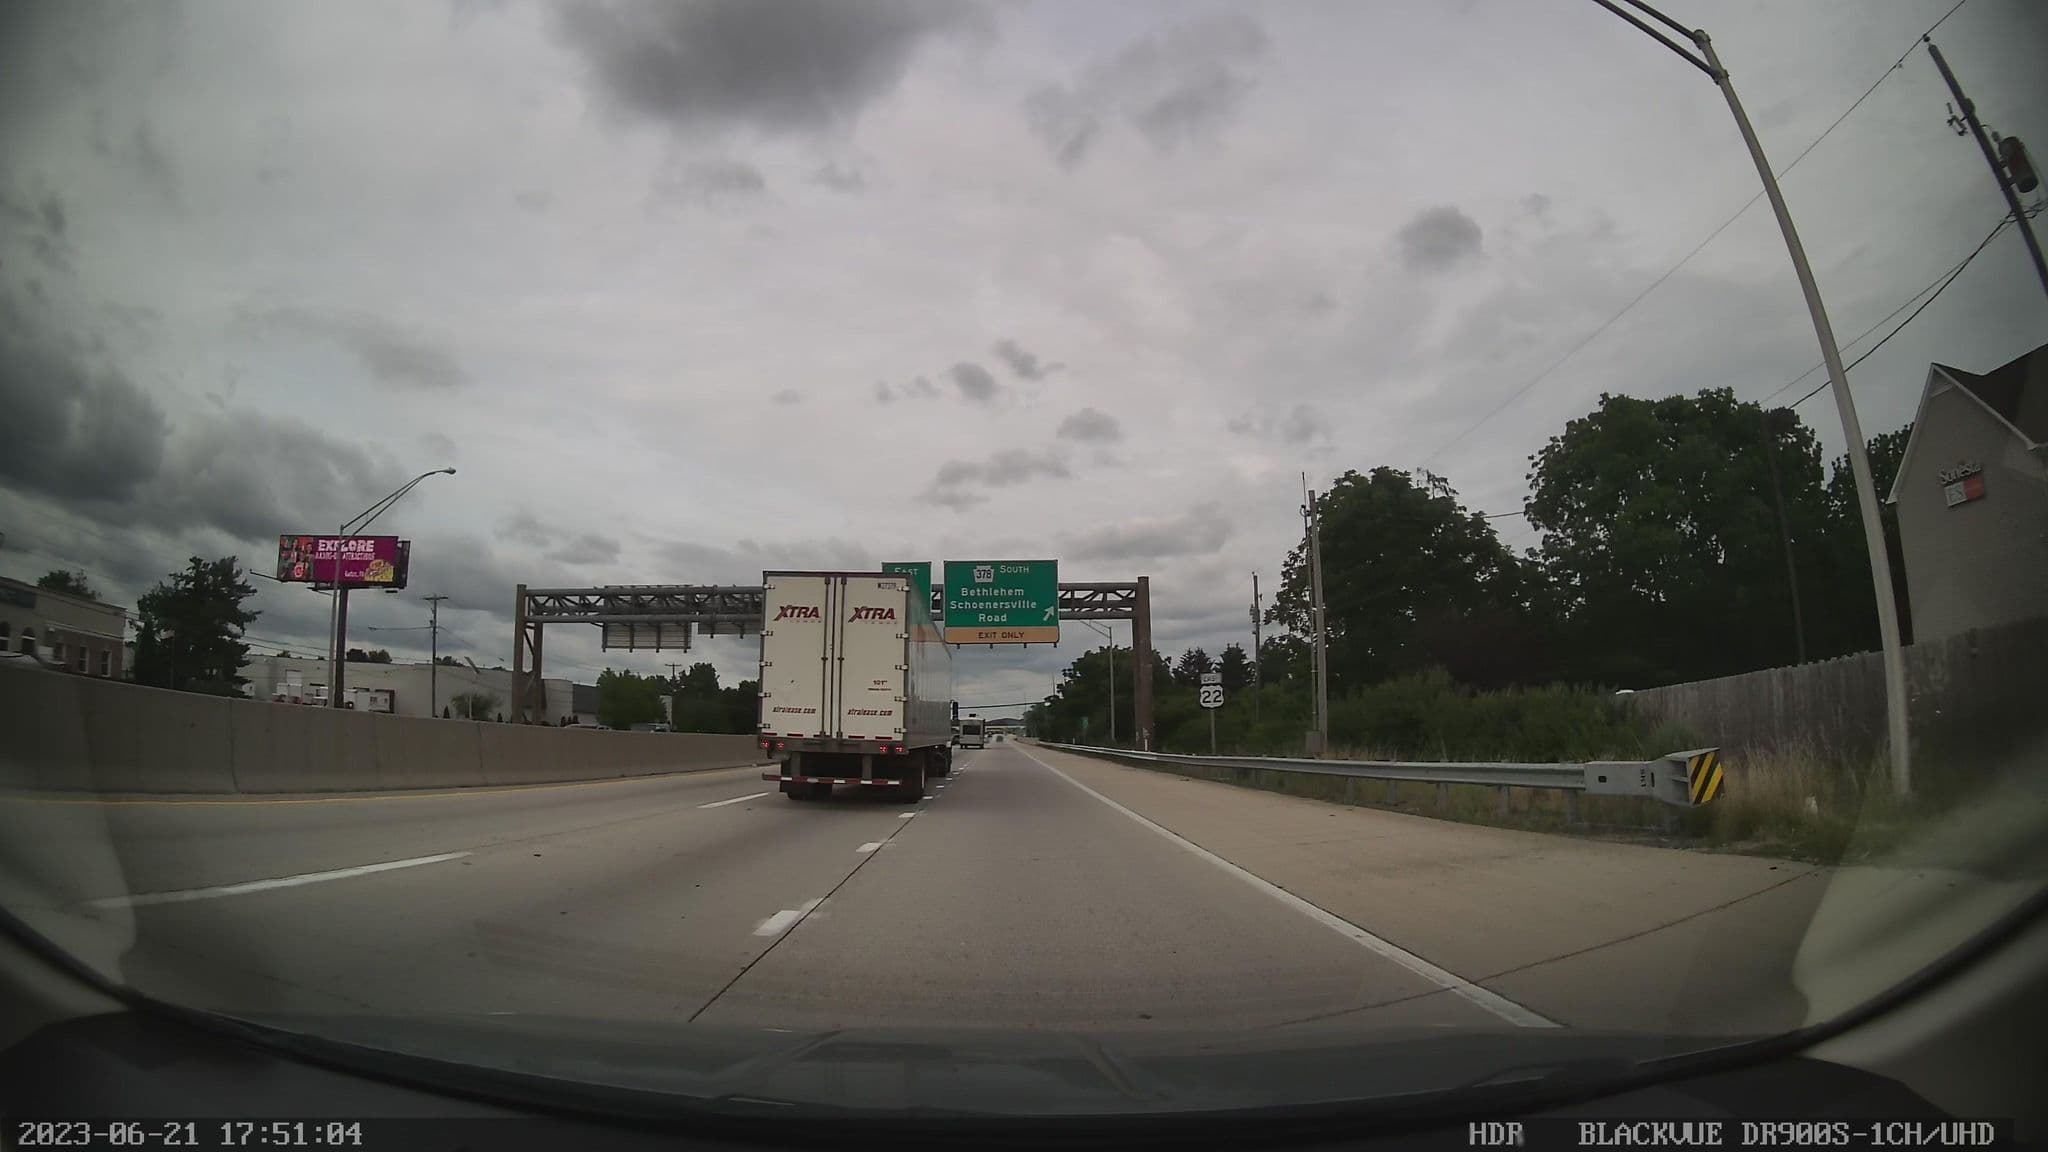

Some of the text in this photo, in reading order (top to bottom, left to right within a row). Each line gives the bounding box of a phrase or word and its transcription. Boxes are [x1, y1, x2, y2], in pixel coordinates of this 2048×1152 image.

[976, 569, 992, 579] 378
[961, 588, 1025, 597] Bethlehem
[950, 600, 1037, 609] Schoenersville
[774, 605, 820, 621] XTRA
[848, 606, 896, 622] XTRA
[978, 613, 1007, 622] Road
[978, 631, 1025, 639] EXIT ONLY
[1202, 690, 1222, 703] 22
